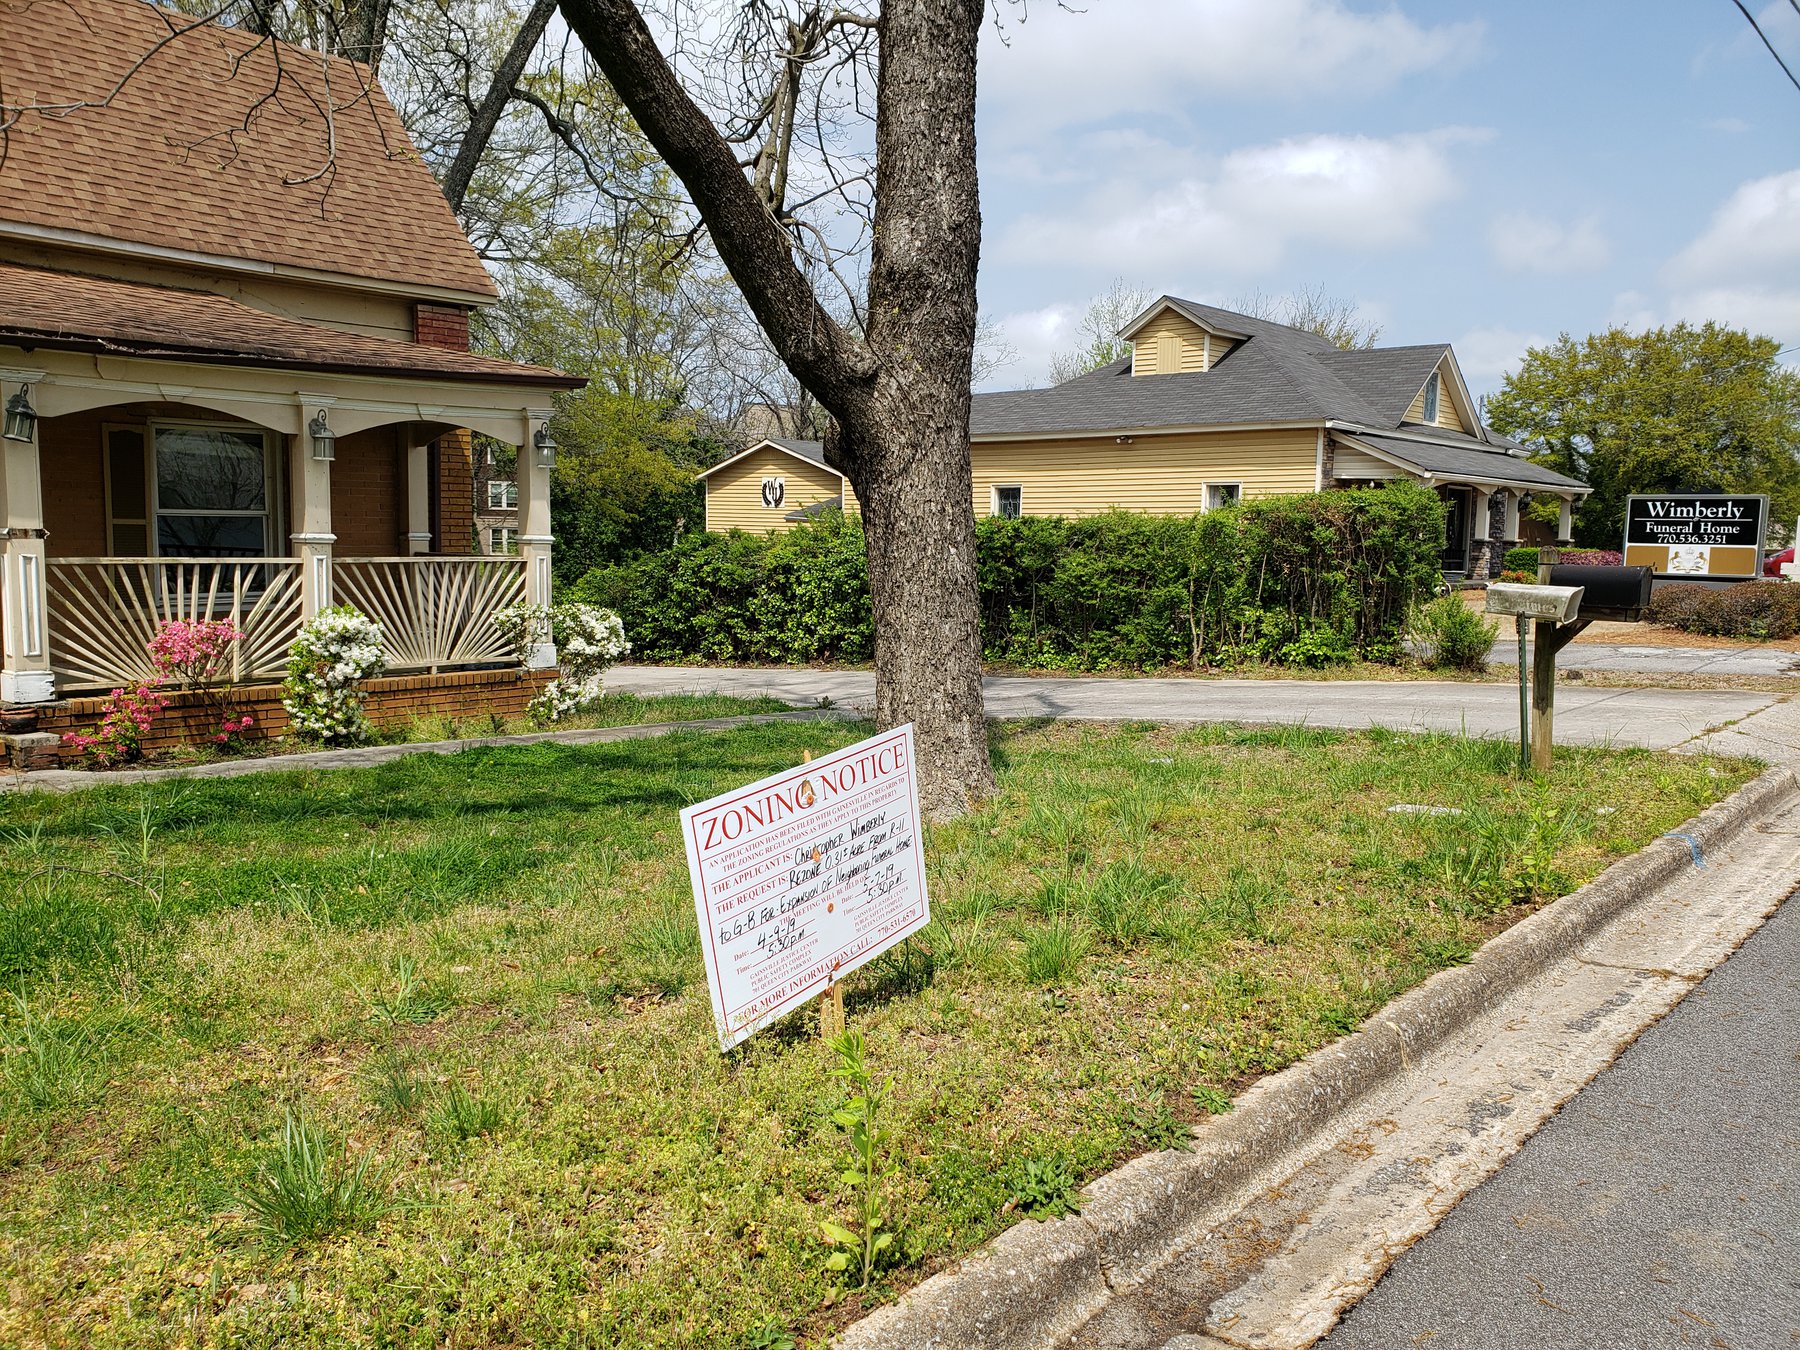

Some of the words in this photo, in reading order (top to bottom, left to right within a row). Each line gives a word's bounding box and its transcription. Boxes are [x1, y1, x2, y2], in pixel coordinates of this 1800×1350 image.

[1647, 501, 1744, 520] Wimberly
[1646, 522, 1693, 533] Funeral
[1700, 523, 1740, 534] Home
[1658, 534, 1727, 544] 770.536.3251
[702, 780, 816, 851] ZONING
[820, 742, 905, 801] NOTICE
[709, 859, 719, 868] AN
[721, 840, 764, 863] APPLICATION
[765, 833, 779, 844] HAS
[779, 826, 796, 838] BEEN
[797, 818, 815, 830] FILED
[815, 810, 831, 821] WITH
[832, 794, 867, 814] GAINESVILLE
[874, 781, 898, 795] REGARDS
[723, 862, 735, 872] THE
[738, 849, 764, 866] ZONING
[765, 831, 808, 854] REGULATIONS
[810, 826, 817, 834] AS
[818, 819, 832, 830] THEY
[834, 811, 849, 822] APPLY
[860, 801, 871, 811] THIS
[872, 789, 896, 805] PROPERTY
[712, 880, 731, 895] THE
[733, 857, 780, 886] APPLICANT
[782, 853, 793, 863] IS:
[863, 864, 894, 893] 5-7-19
[716, 899, 735, 915] THE
[737, 879, 776, 906] REQUEST
[778, 875, 788, 886] IS:
[779, 915, 792, 925] THE
[793, 900, 820, 920] MEETING
[821, 892, 835, 903] WILL
[837, 887, 843, 896] BE
[844, 879, 859, 891] HELD
[841, 894, 853, 904] Date:
[843, 906, 855, 916] Time:
[757, 918, 796, 949] 4-9-19
[734, 950, 749, 961] Date:
[760, 986, 788, 1010] MORE
[789, 951, 849, 992] INFORMATION
[850, 937, 873, 956] CALL:
[877, 908, 916, 937] 770-531-6570
[781, 949, 799, 963] JUSTICE
[800, 939, 818, 952] CENTER
[737, 964, 752, 975] Time:
[751, 973, 769, 987] PUBLIC
[770, 963, 788, 975] SAFETY
[789, 950, 811, 965] COMPLEX
[761, 977, 777, 990] QUEEN
[778, 970, 789, 979] CITY
[790, 957, 811, 972] PARKWAY
